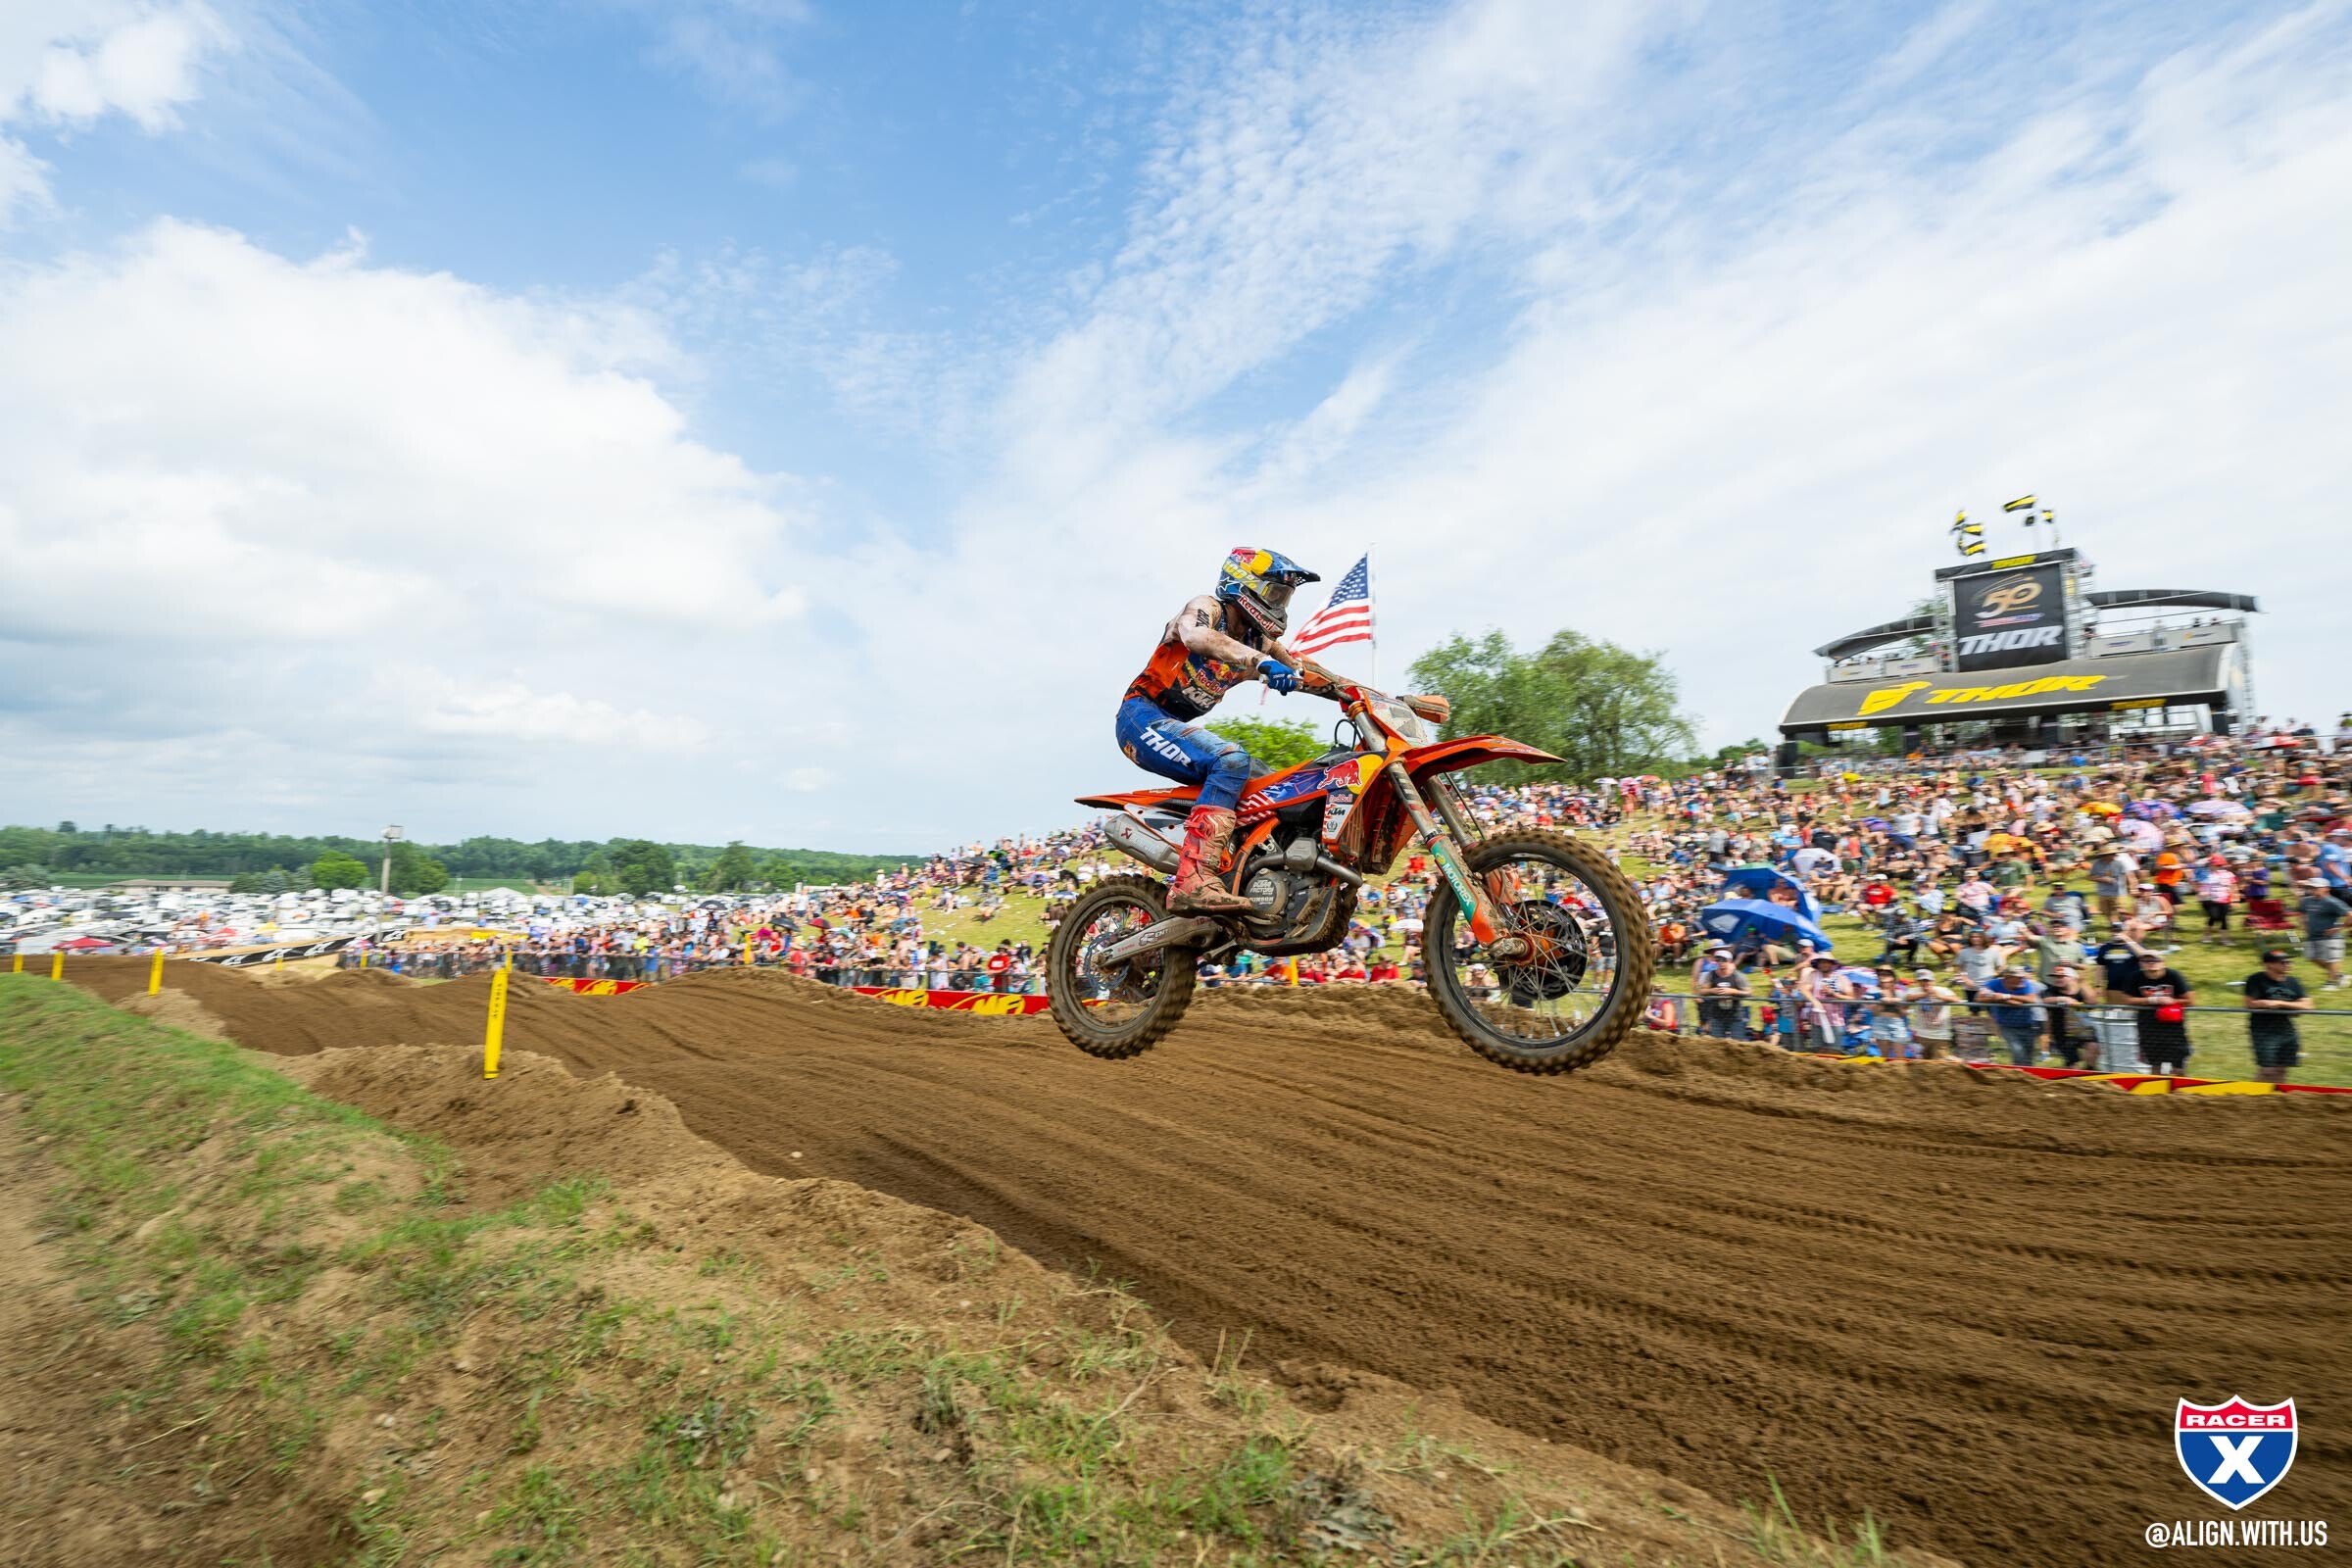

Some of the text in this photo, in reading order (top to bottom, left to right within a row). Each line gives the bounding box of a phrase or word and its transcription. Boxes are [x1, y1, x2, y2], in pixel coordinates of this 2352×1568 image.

[1222, 560, 1258, 590] 100%
[1975, 582, 2043, 618] 50
[1958, 625, 2064, 657] THOR
[1925, 674, 2108, 705] THOR
[1140, 726, 1192, 767] THOR
[1443, 862, 1473, 906] MOTOREX
